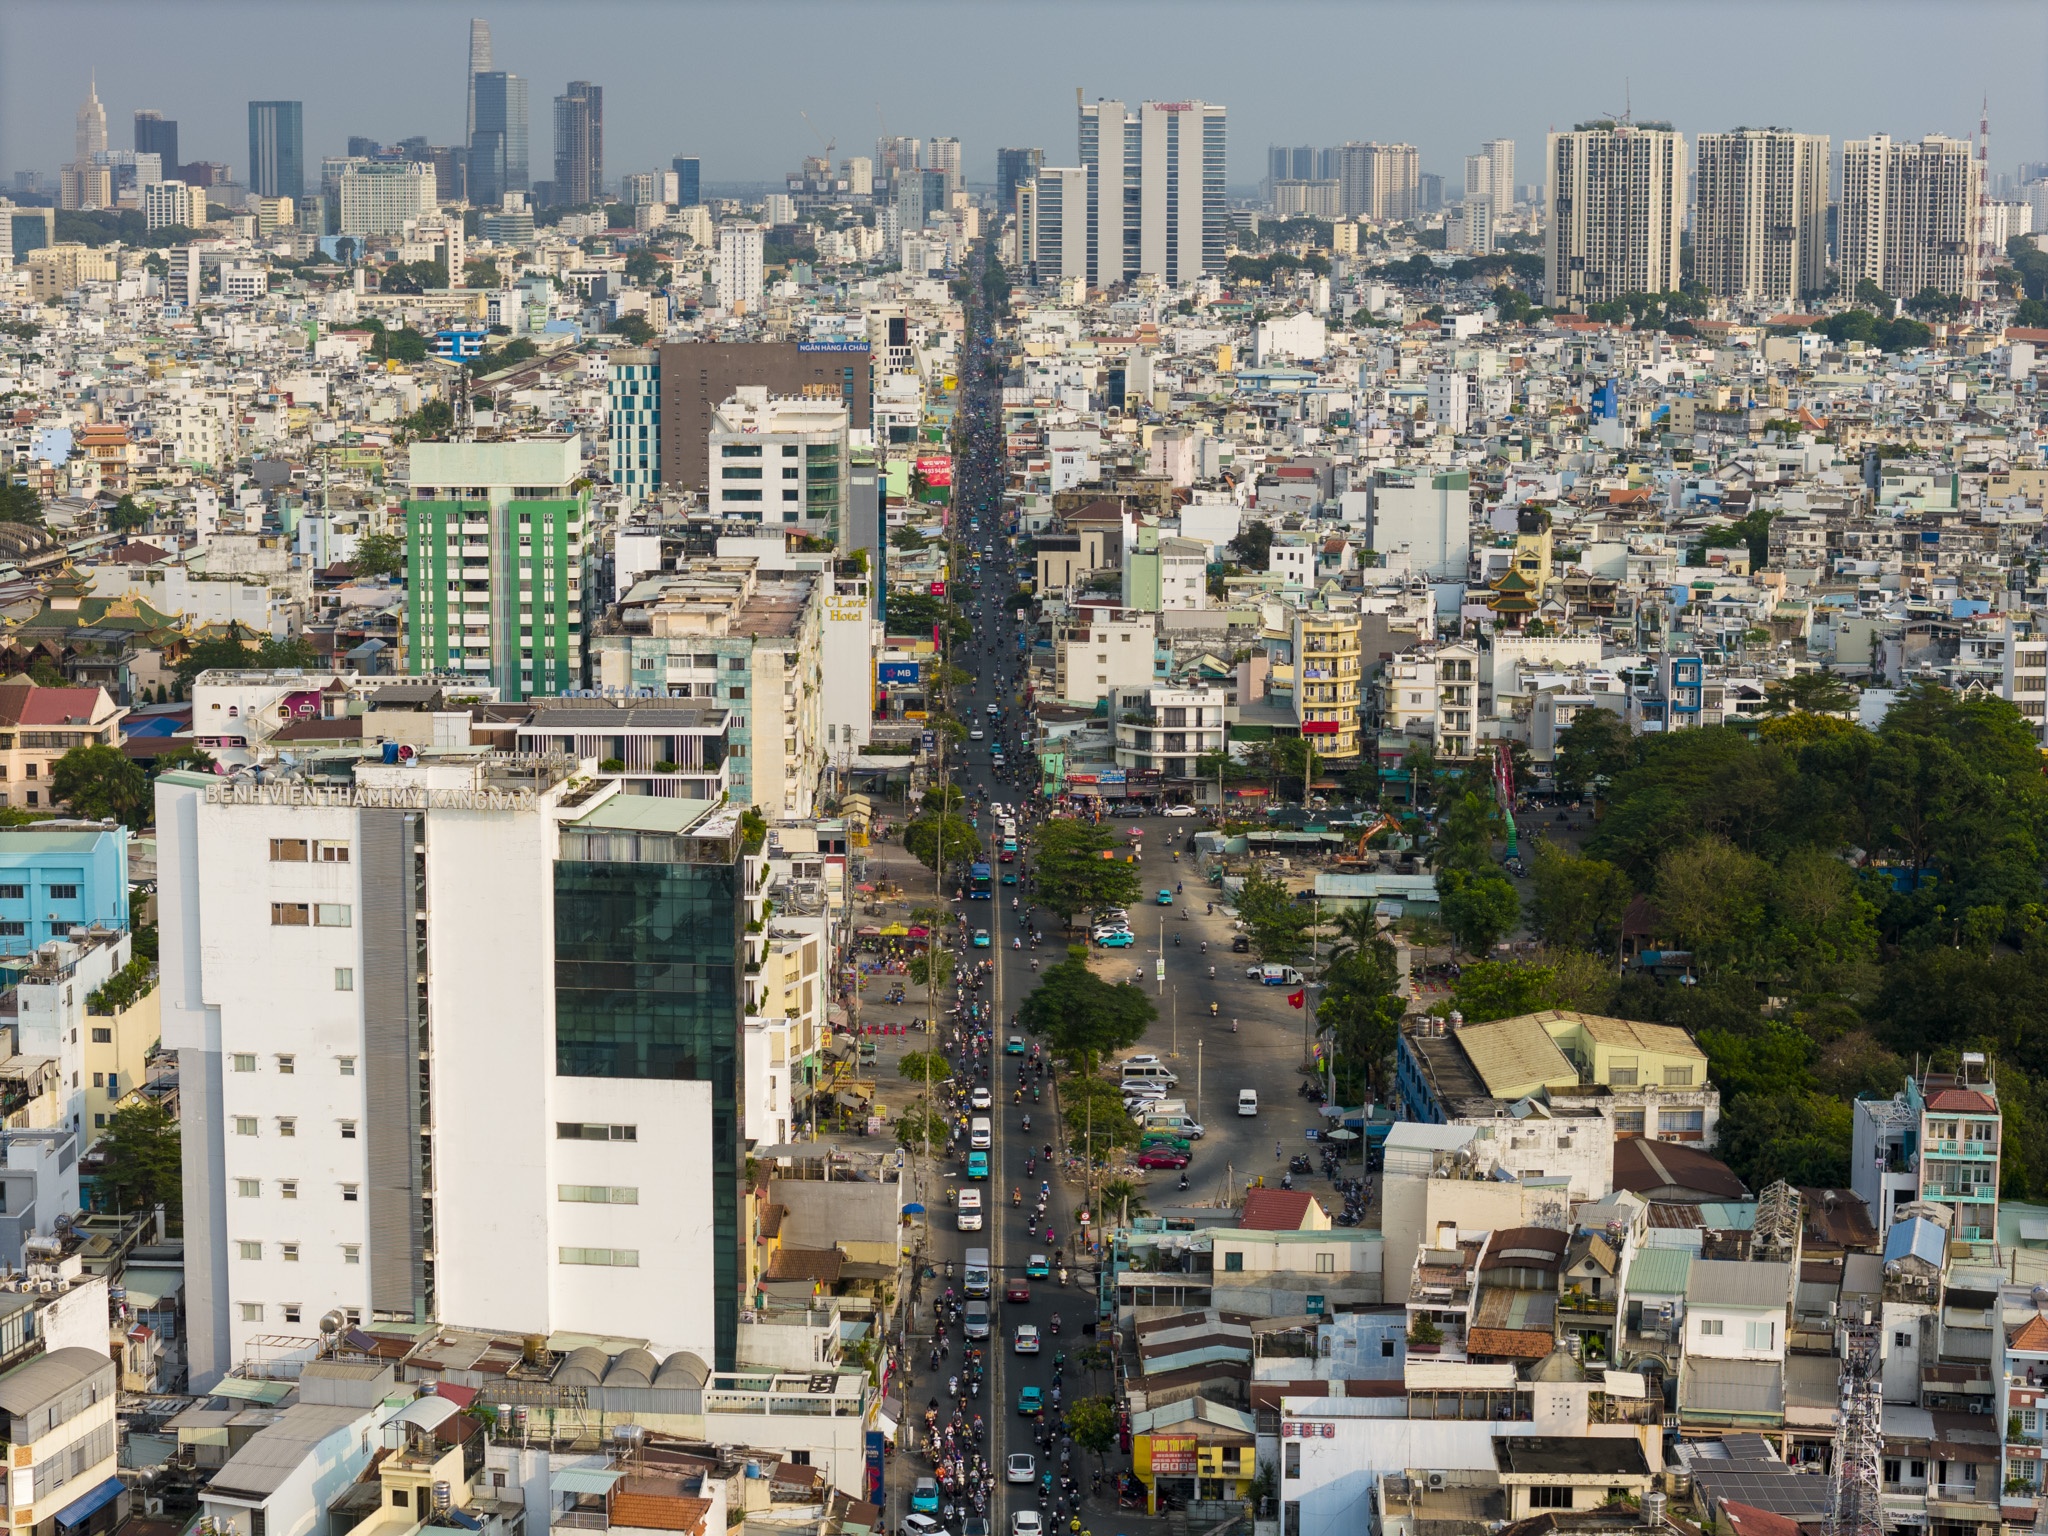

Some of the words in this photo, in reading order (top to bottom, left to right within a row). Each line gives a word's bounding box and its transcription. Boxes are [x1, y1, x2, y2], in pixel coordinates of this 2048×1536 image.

[1153, 102, 1193, 111] viettel
[842, 343, 848, 351] Á
[849, 343, 869, 351] CHÂU
[830, 610, 863, 621] Hotel
[897, 669, 911, 677] MB
[429, 789, 537, 811] KANGNAM
[1152, 1439, 1169, 1452] LONG
[1912, 1512, 1925, 1520] Spa
